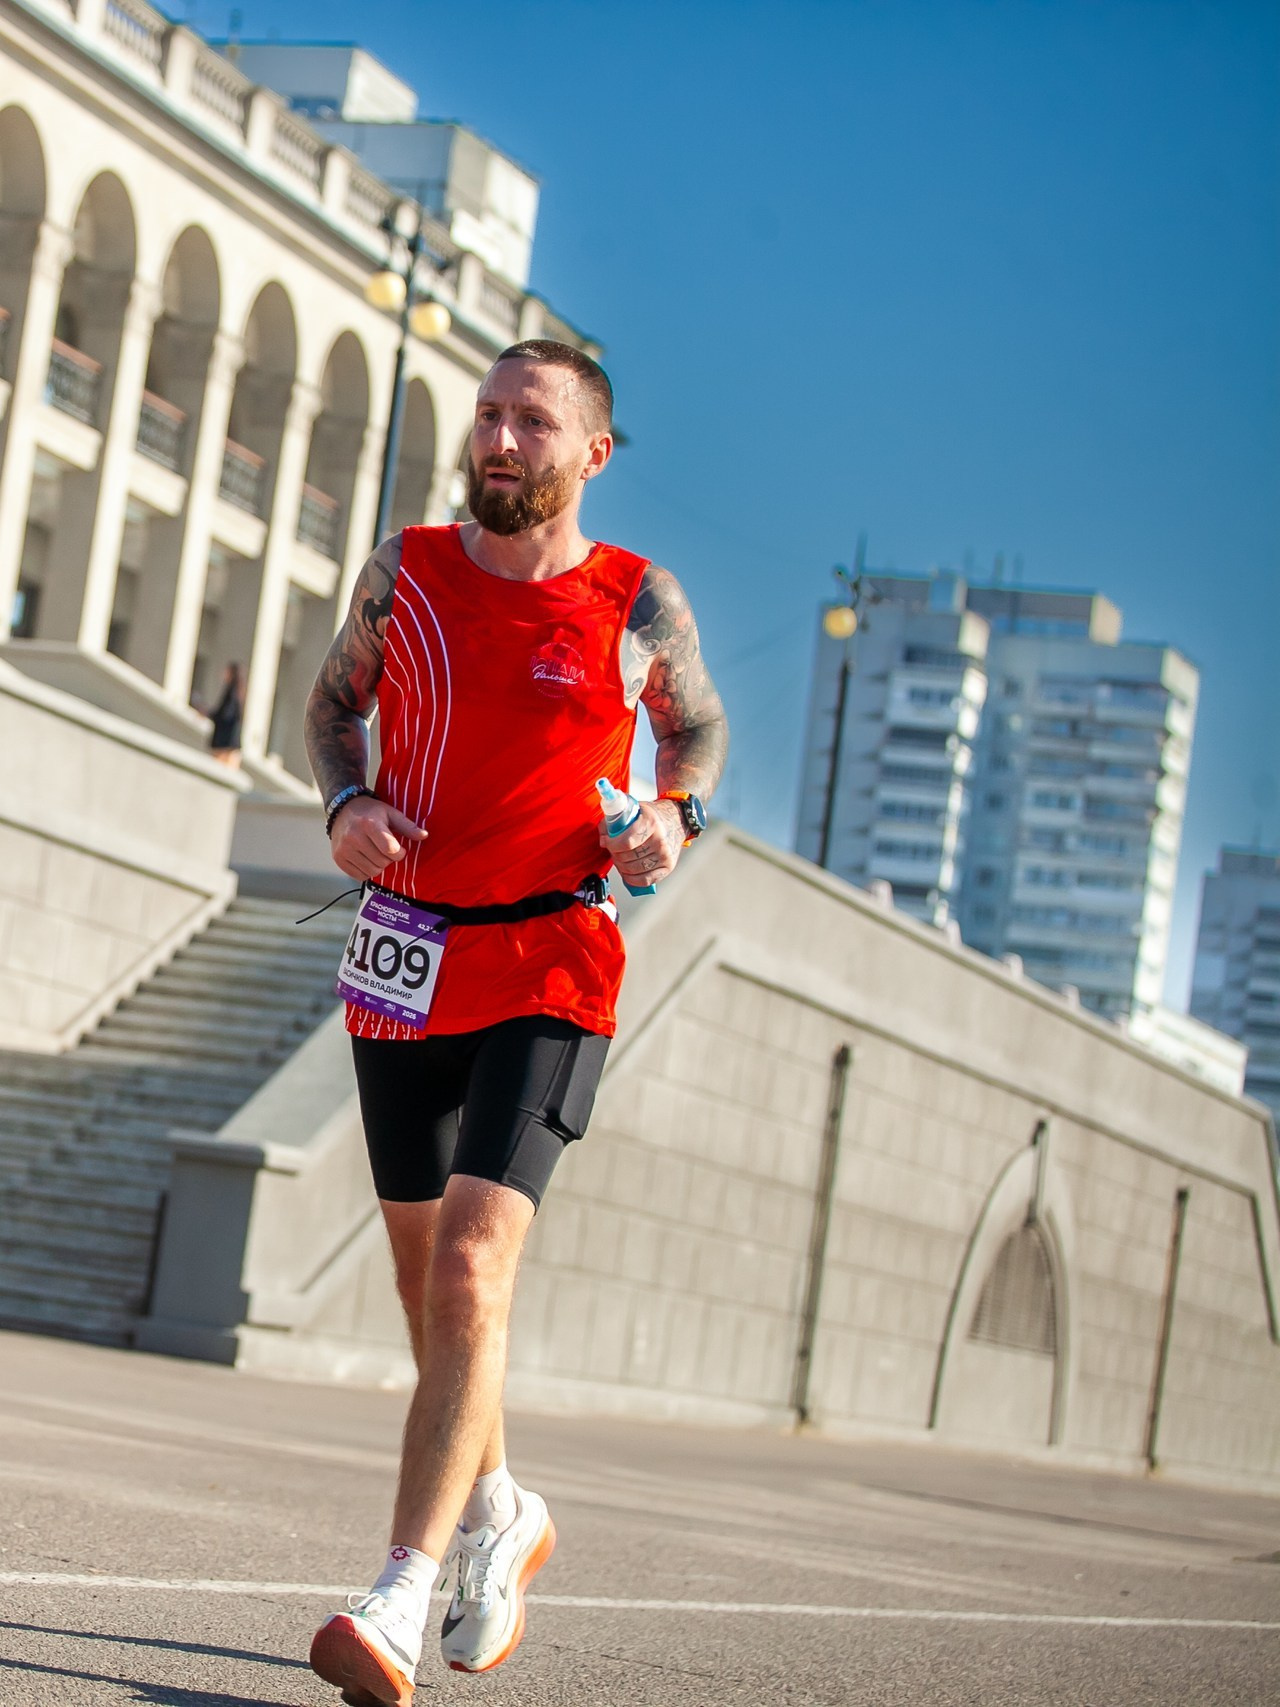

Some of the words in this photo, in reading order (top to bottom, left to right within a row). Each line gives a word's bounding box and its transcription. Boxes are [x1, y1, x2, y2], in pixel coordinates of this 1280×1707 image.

[377, 911, 398, 923] МОСТЫ
[346, 922, 431, 990] 4109
[369, 980, 413, 1000] ВЛАДИМИР
